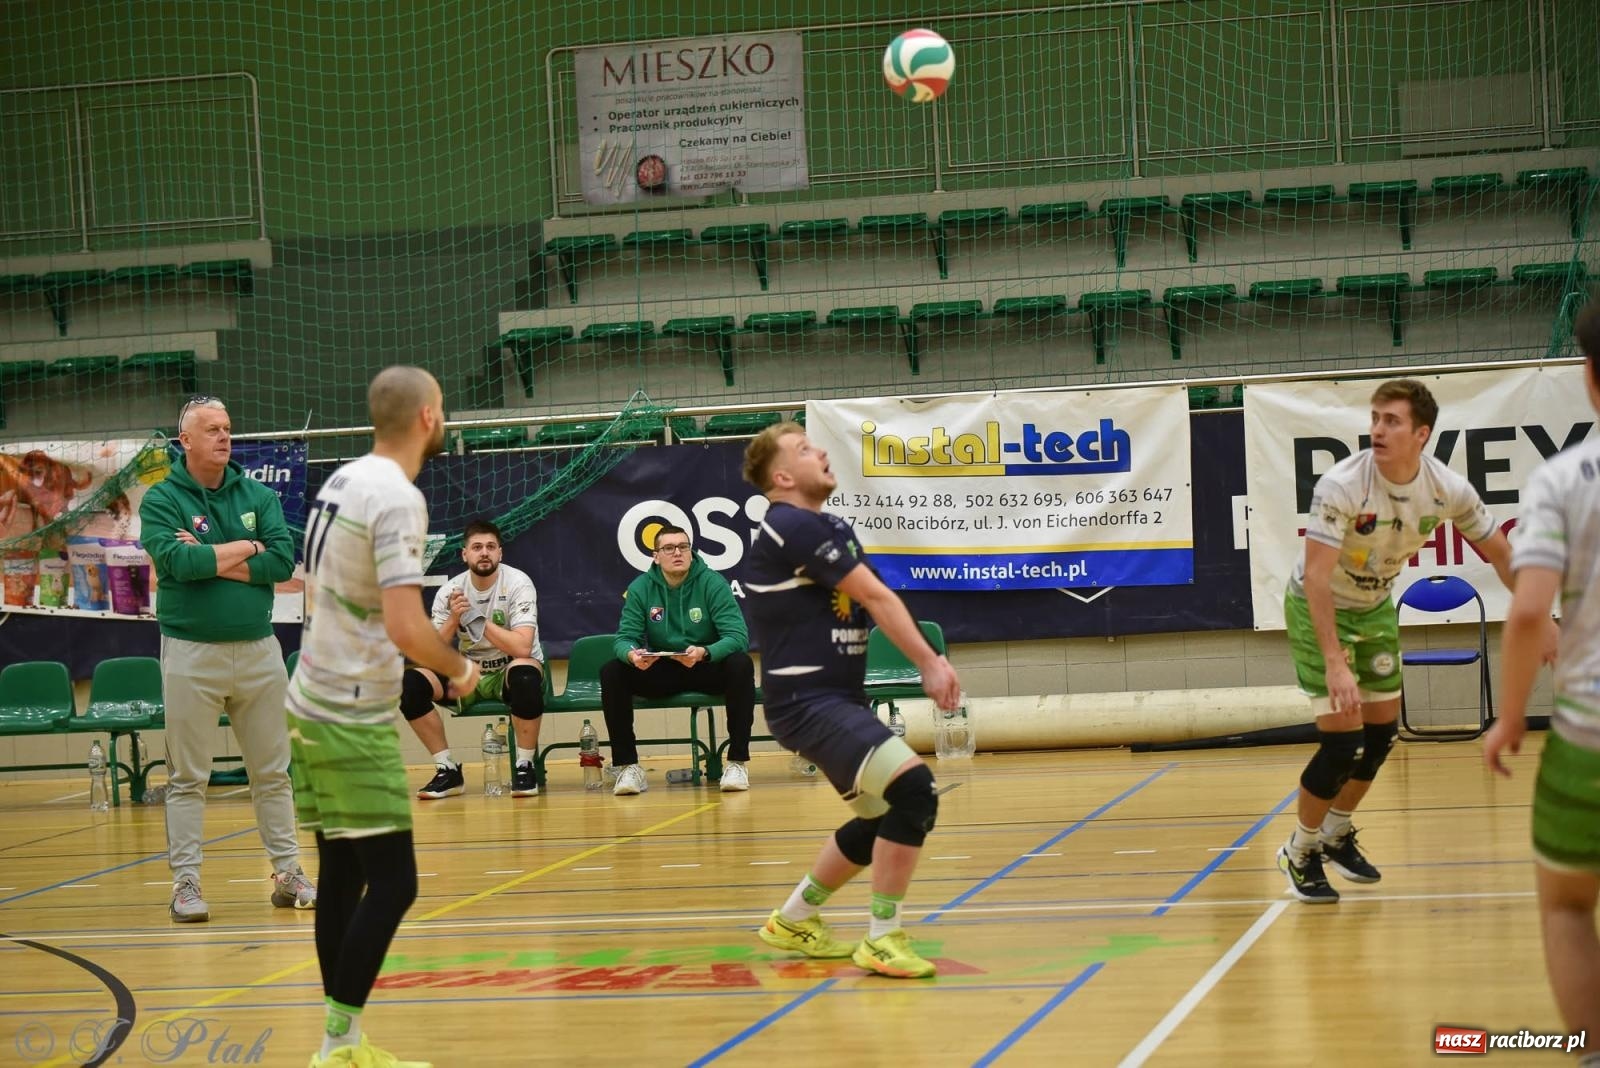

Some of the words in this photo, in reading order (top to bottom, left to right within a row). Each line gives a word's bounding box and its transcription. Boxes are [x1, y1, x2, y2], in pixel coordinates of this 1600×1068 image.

[603, 43, 775, 87] MIESZKO
[608, 109, 660, 122] Operator
[664, 103, 717, 117] urządzeń
[720, 97, 799, 112] cukierniczych
[609, 120, 670, 134] Pracownik
[673, 115, 743, 130] produkcyjny
[679, 136, 729, 148] Czekamy
[733, 134, 747, 143] na
[751, 131, 791, 143] Ciebie!
[862, 419, 1131, 475] instal-tech
[826, 493, 849, 507] tel.
[854, 494, 871, 508] 32
[876, 495, 904, 508] 414
[909, 495, 928, 508] 92
[933, 494, 956, 509] 88,
[965, 494, 994, 508] 502
[999, 493, 1028, 508] 632
[1033, 491, 1067, 507] 695,
[1075, 491, 1104, 505] 606
[1108, 489, 1138, 504] 363
[1143, 487, 1173, 502] 647
[841, 516, 893, 530] 7-400
[897, 515, 969, 532] Racibórz,
[974, 516, 992, 530] ul.
[998, 515, 1008, 530] J.
[1013, 518, 1041, 529] von
[1047, 510, 1148, 527] Eichendorffa
[1153, 511, 1162, 524] 2
[910, 560, 1088, 582] www.instal-tech.pl
